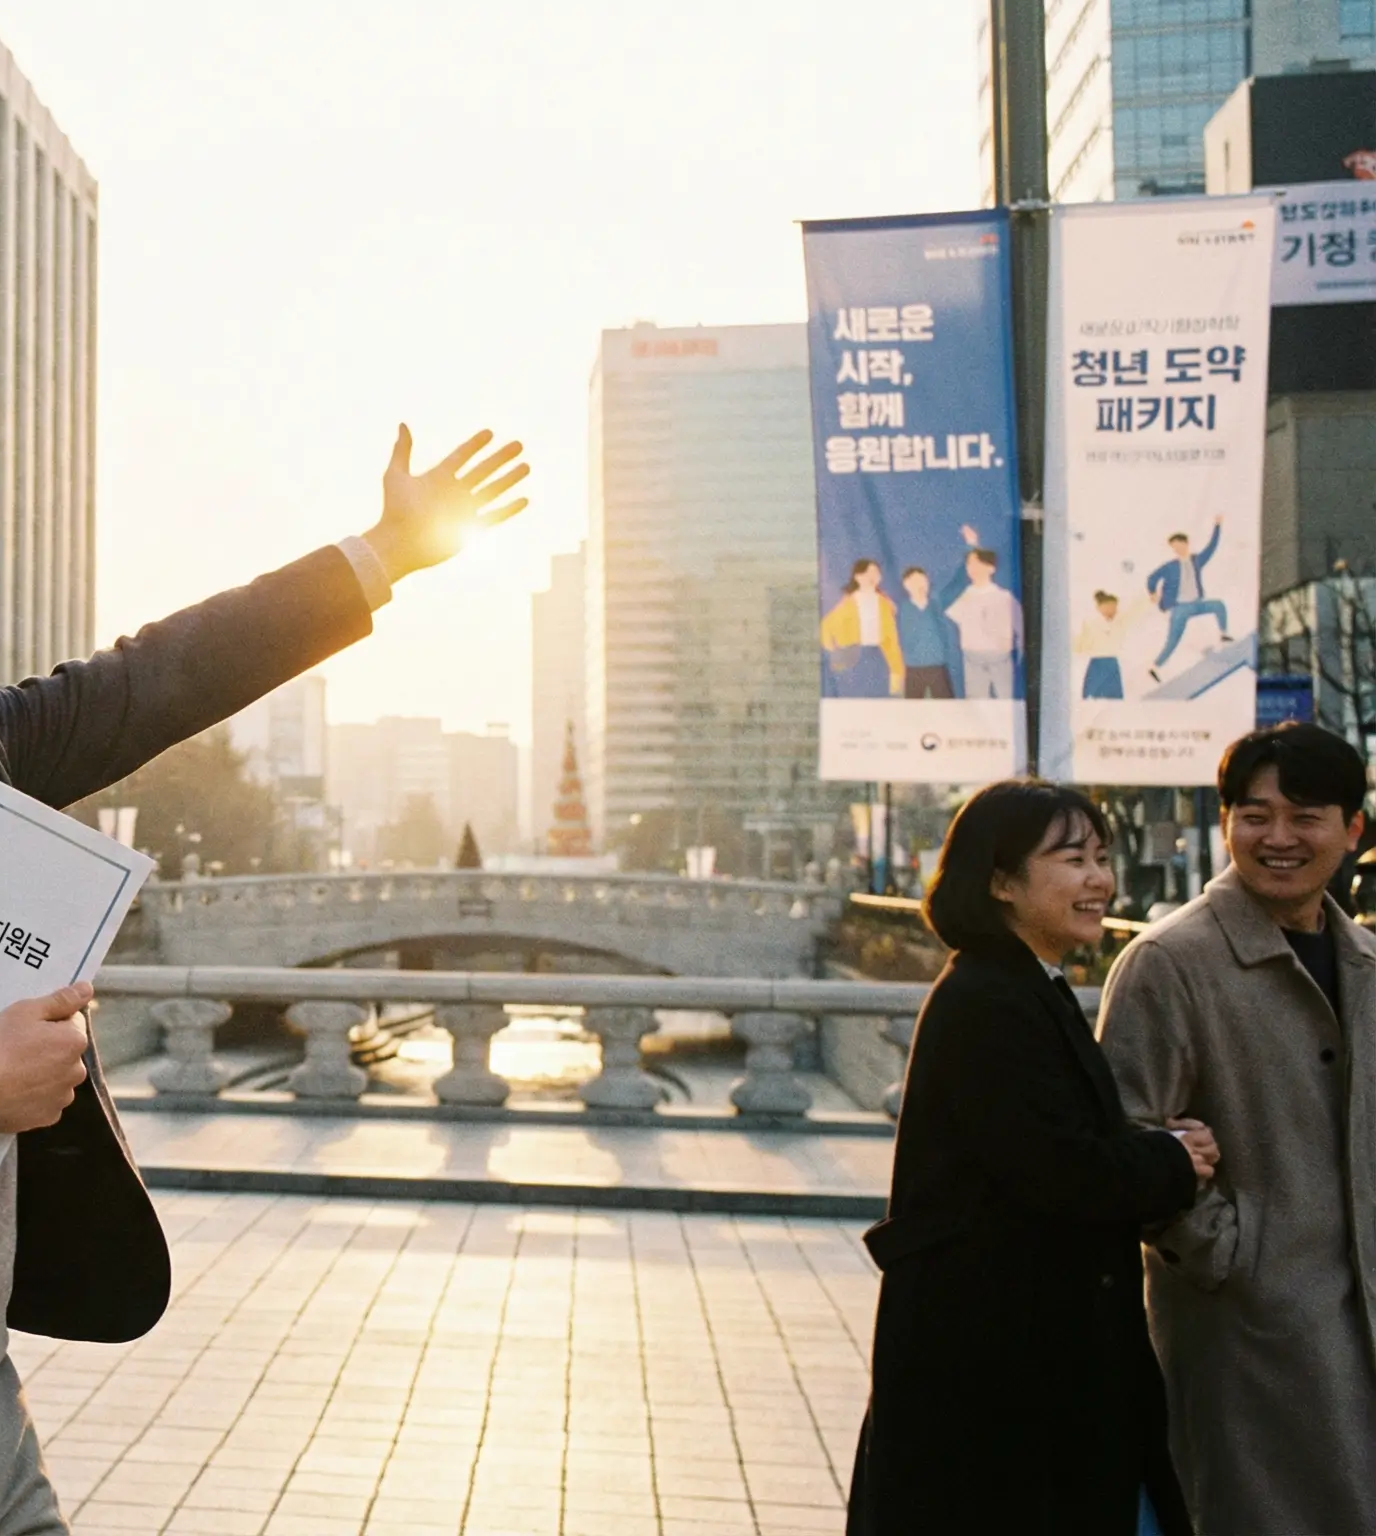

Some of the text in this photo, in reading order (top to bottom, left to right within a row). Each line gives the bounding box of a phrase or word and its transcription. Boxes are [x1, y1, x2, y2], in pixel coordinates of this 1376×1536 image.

[833, 304, 934, 342] 새로운
[836, 349, 913, 386] 시작,
[1071, 345, 1246, 388] 청년 도약
[837, 391, 904, 429] 함께
[1096, 394, 1216, 432] 패키지
[825, 433, 1004, 474] 응원합니다.
